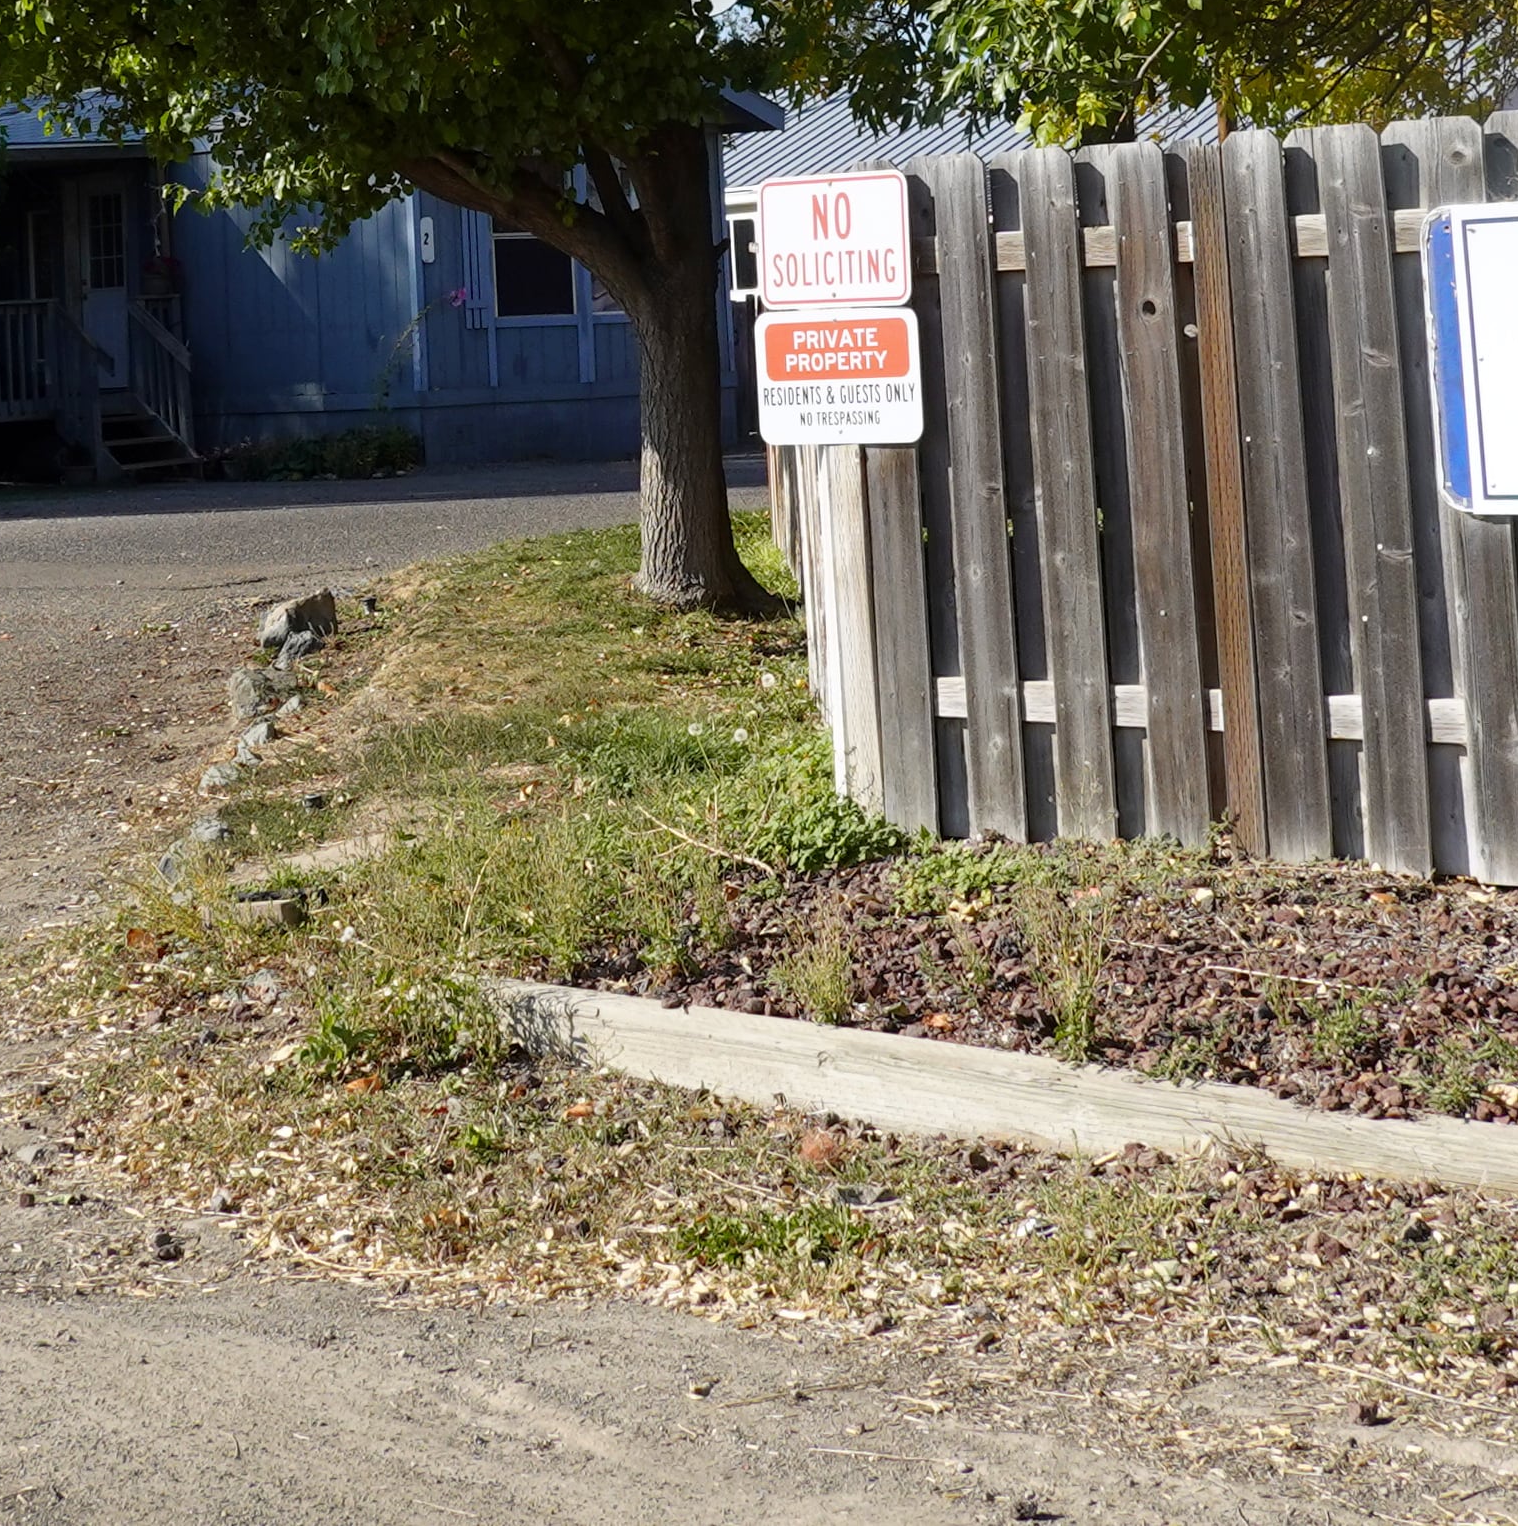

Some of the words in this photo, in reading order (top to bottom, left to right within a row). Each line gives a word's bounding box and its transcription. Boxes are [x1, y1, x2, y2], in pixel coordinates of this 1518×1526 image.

[812, 192, 851, 240] NO
[423, 232, 430, 245] 2
[773, 248, 896, 287] SOLICITING
[793, 327, 879, 350] PRIVATE
[785, 350, 888, 372] PROPERTY
[763, 385, 822, 406] RESIDENTS
[826, 385, 835, 404] &
[840, 384, 881, 405] GUESTS
[886, 382, 915, 403] ONLY
[800, 412, 813, 427] NO
[817, 410, 881, 425] TRESPASSING
